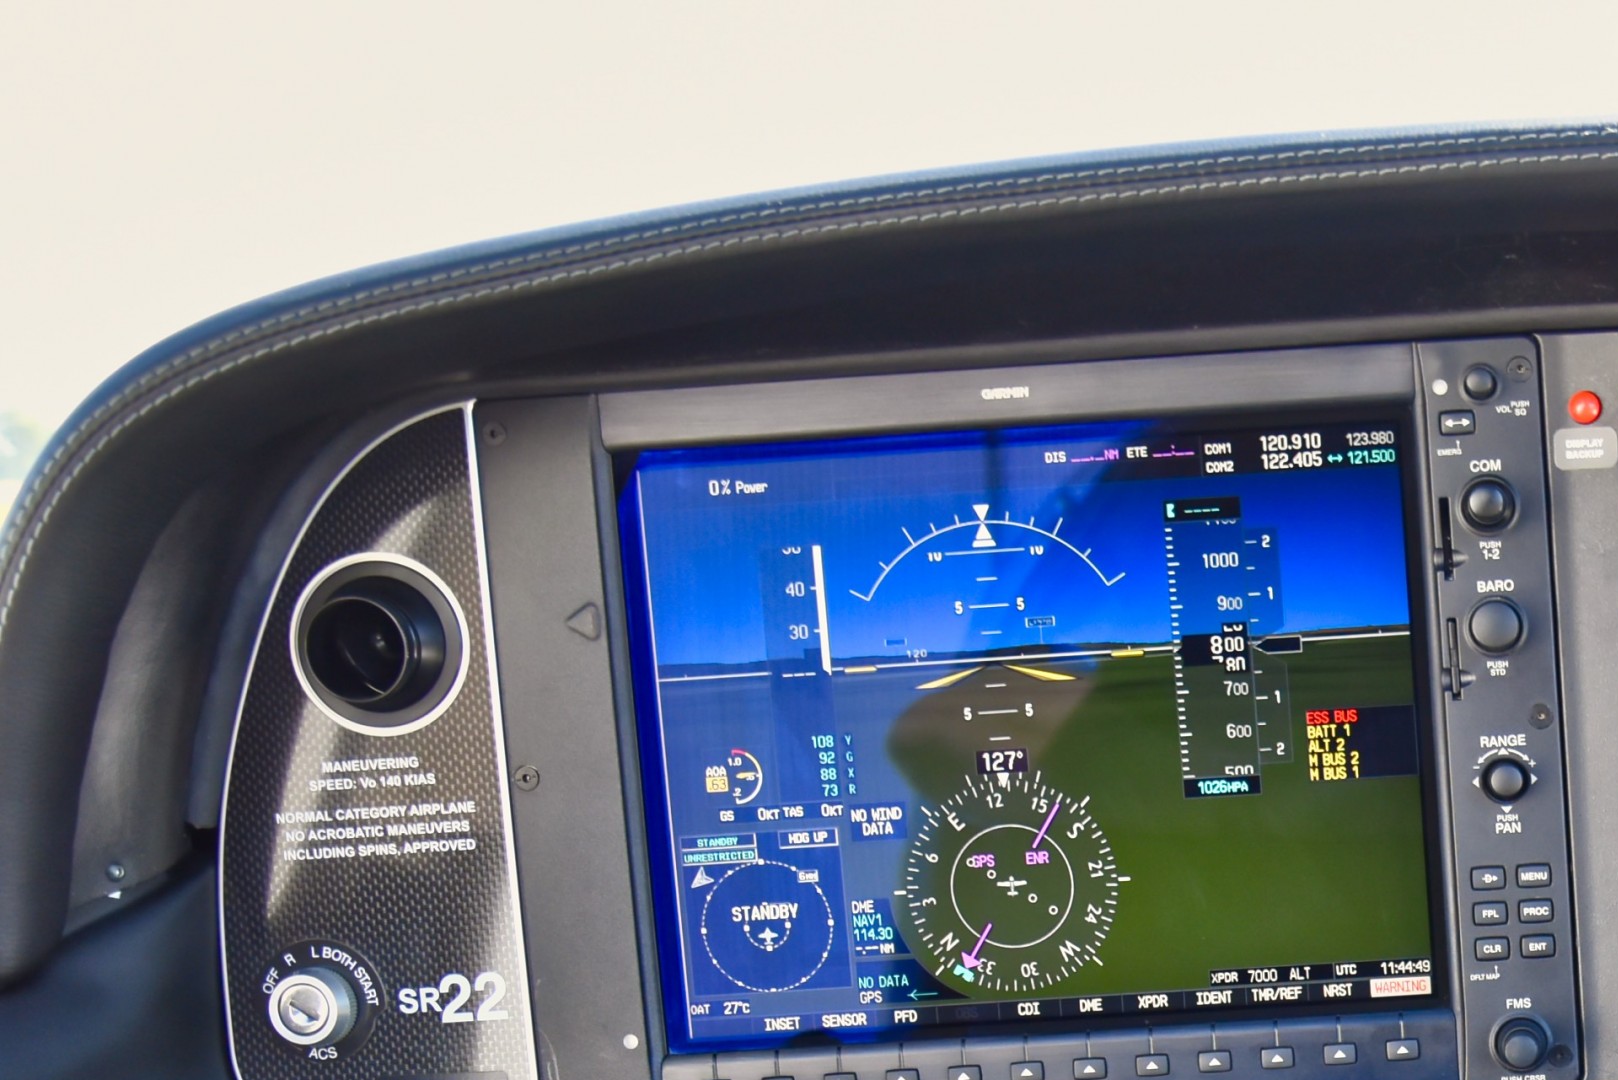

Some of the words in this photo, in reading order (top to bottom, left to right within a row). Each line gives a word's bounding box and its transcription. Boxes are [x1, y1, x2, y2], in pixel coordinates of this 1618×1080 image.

[981, 387, 1030, 400] GARMIN
[1204, 442, 1232, 455] COM1
[1260, 433, 1322, 451] 120.910
[1346, 431, 1395, 446] 123.980
[1206, 460, 1234, 474] COM2
[1261, 452, 1323, 470] 122.405
[1347, 450, 1395, 465] 121.500
[1469, 459, 1502, 473] COM
[1202, 552, 1239, 569] 1000
[1476, 579, 1514, 593] BARO
[1217, 596, 1243, 611] 900
[1305, 711, 1330, 725] ESS
[1334, 709, 1358, 722] BUS
[1480, 733, 1526, 748] RANGE
[321, 756, 419, 774] MANEUVERING
[309, 779, 357, 793] SPEED:
[360, 777, 376, 789] Vo
[379, 775, 401, 788] 140
[404, 773, 436, 786] KIAS
[1198, 780, 1249, 795] 1026HPA
[275, 810, 333, 825] NORMAL
[335, 806, 406, 821] CATEGORY
[409, 801, 476, 815] AIRPLANE
[851, 810, 867, 823] NO
[871, 807, 902, 821] WIND
[285, 830, 305, 843] NO
[308, 826, 384, 841] ACROBATIC
[387, 820, 470, 836] MANEUVERS
[862, 822, 893, 836] DATA
[1495, 822, 1521, 834] PAN
[788, 832, 810, 845] HDG
[813, 831, 828, 843] UP
[283, 846, 355, 862] INCLUDING
[358, 842, 401, 857] SPINS,
[403, 838, 476, 854] APPROVED
[684, 851, 754, 863] UNRESTRICTED
[972, 855, 995, 868] GPS
[1025, 852, 1050, 865] ENR
[1520, 871, 1548, 881] MENU
[731, 903, 798, 922] STANDBY
[851, 900, 874, 913] DME
[1523, 906, 1549, 917] PROC
[853, 914, 882, 927] NAV1
[854, 927, 893, 941] 114.30
[322, 946, 358, 971] BOTH
[1335, 963, 1357, 976] UTC
[1381, 959, 1430, 976] 11:44:49
[262, 967, 280, 995] OFF
[1211, 971, 1239, 984] XPDR
[1248, 968, 1278, 983] 7000
[1289, 967, 1311, 981] ALT
[353, 966, 379, 1006] START
[1323, 983, 1353, 998] NRST
[1375, 979, 1427, 994] WARNING
[399, 972, 509, 1024] SR22
[1138, 992, 1168, 1008] XPDR
[1196, 990, 1233, 1005] IDENT
[1251, 986, 1302, 1002] TMR/REF
[1017, 1003, 1041, 1017] CDI
[1079, 999, 1103, 1013] DME
[1506, 998, 1532, 1010] FMS
[764, 1016, 800, 1031] INSET
[821, 1012, 867, 1028] SENSOR
[894, 1009, 918, 1023] PFD
[308, 1047, 338, 1060] ACS
